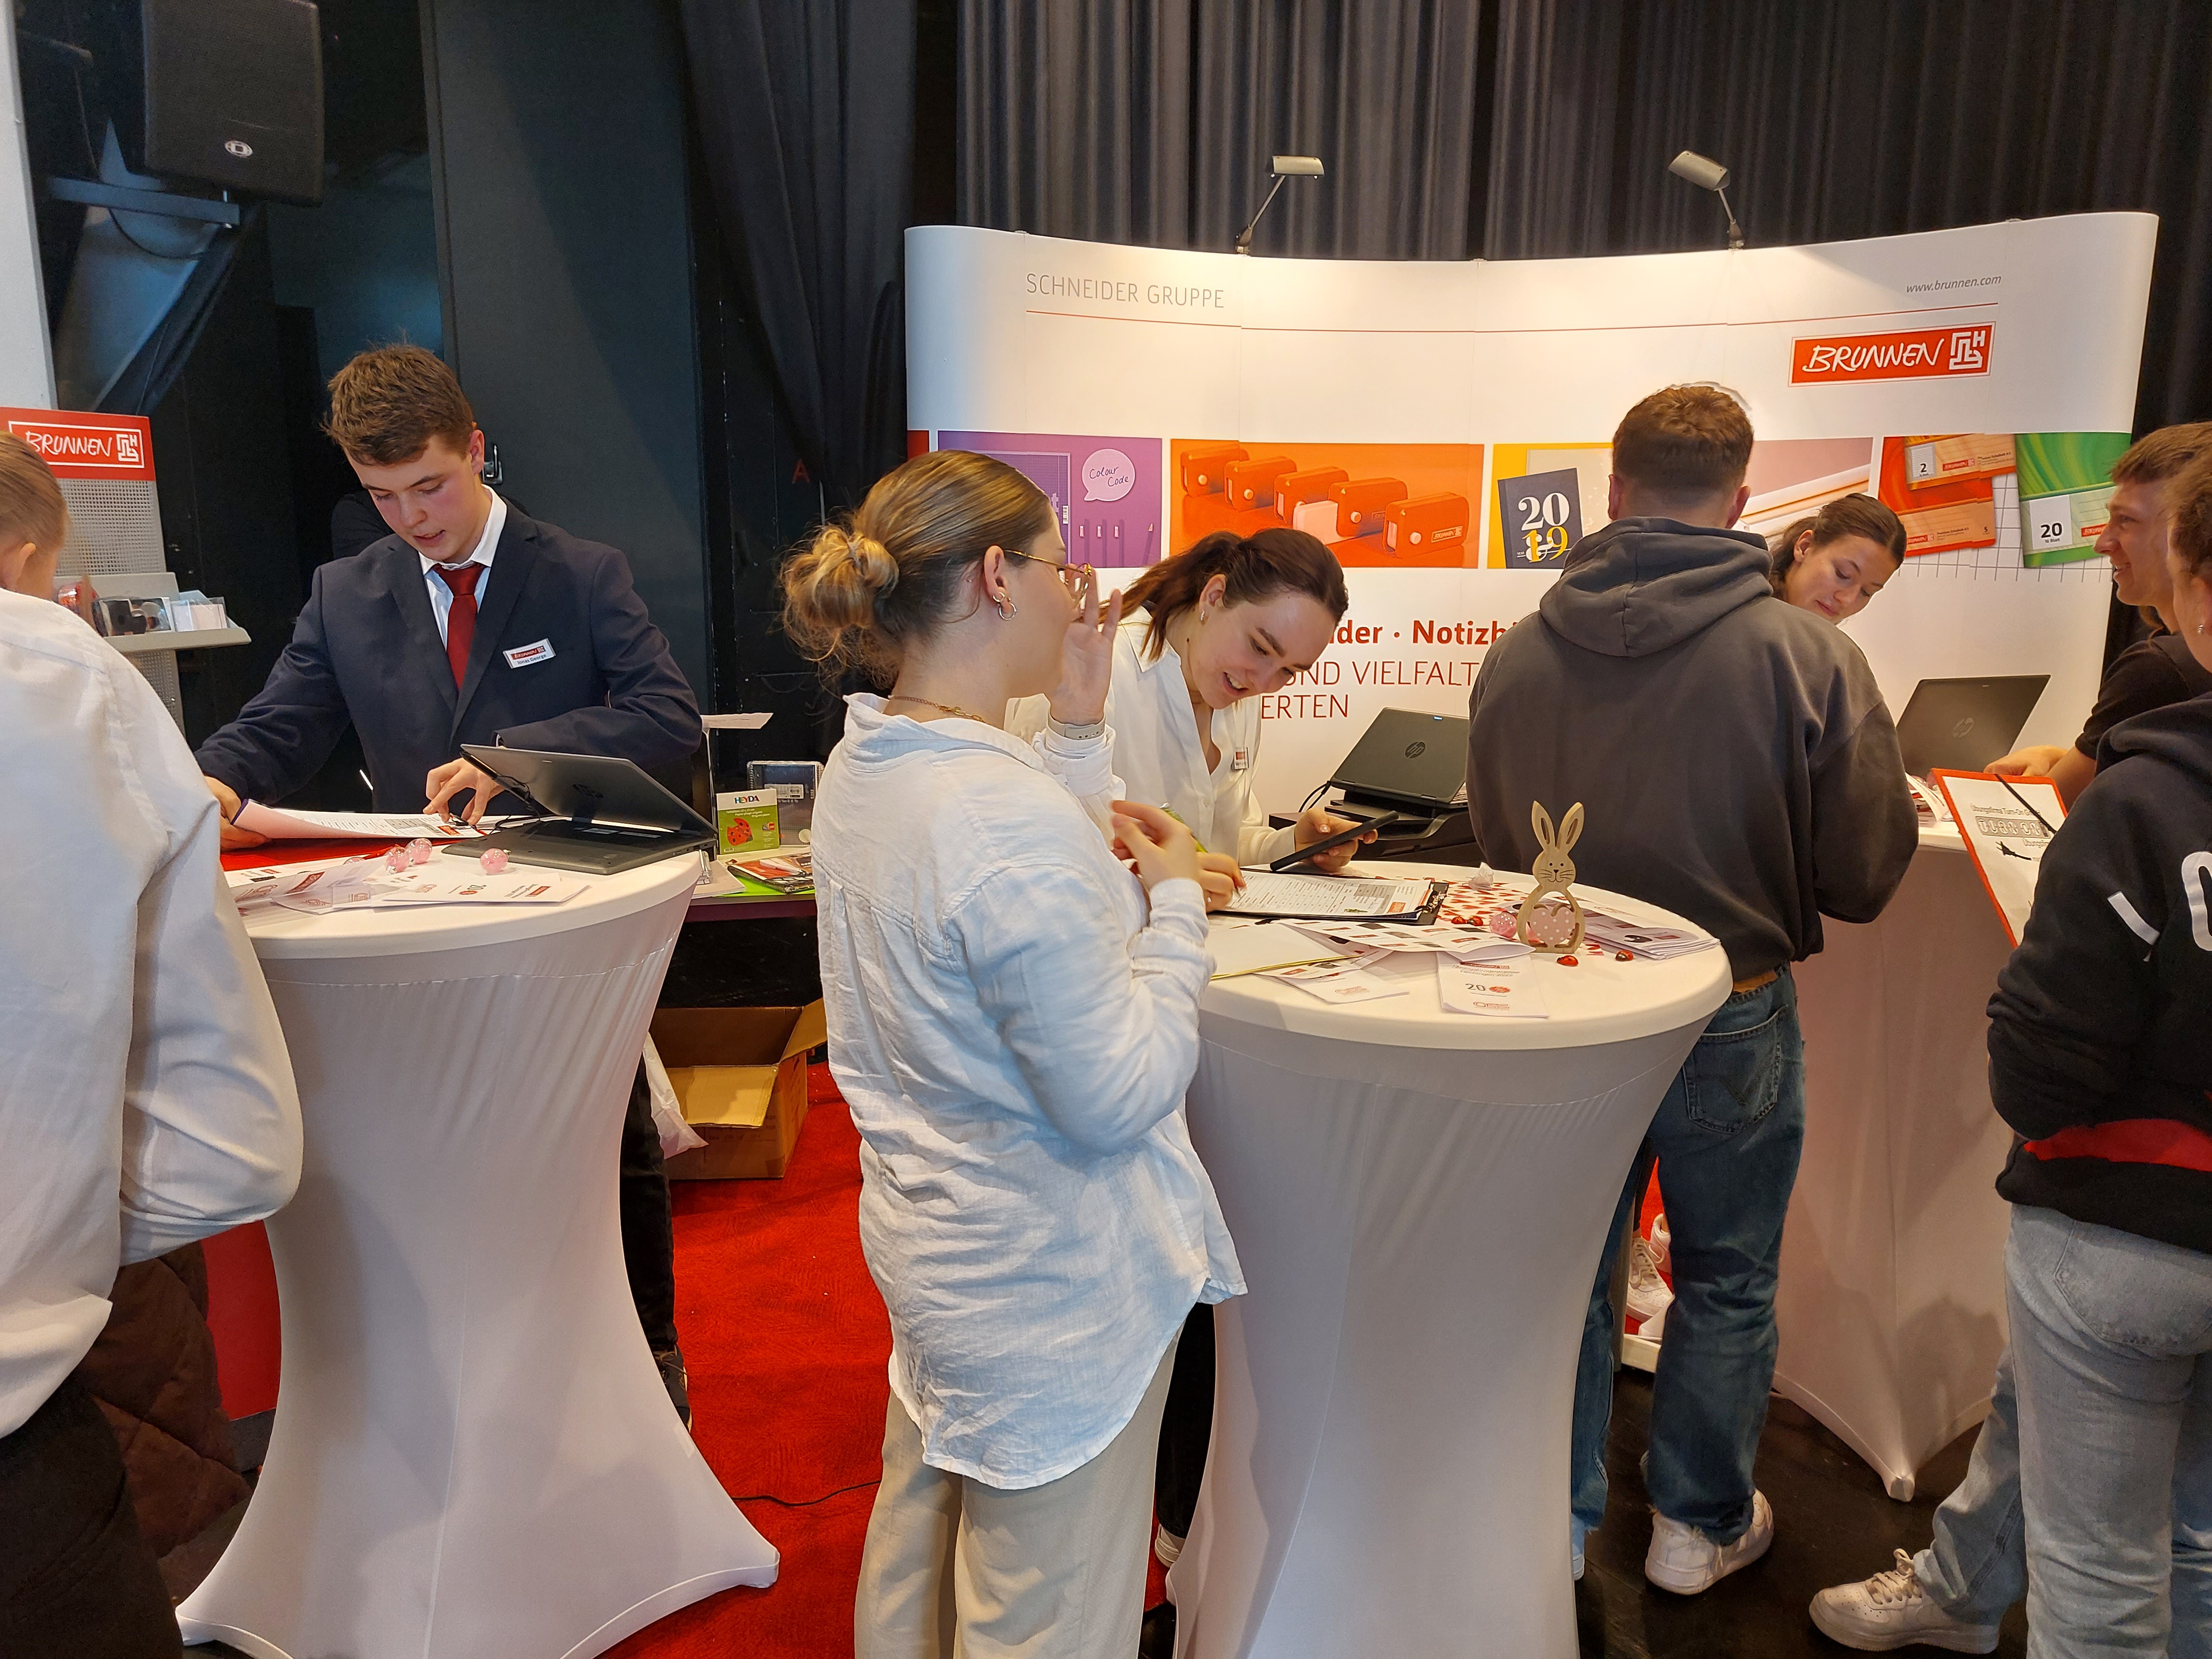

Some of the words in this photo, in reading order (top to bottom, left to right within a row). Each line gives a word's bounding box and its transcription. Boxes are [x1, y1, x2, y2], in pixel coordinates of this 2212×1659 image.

[1026, 273, 1139, 302] SCHNEIDER
[1147, 285, 1225, 309] GRUPPE
[1906, 276, 2002, 293] www.brunnen.com
[1802, 338, 1945, 372] BRUNNEN
[25, 430, 113, 457] BRUNNEN
[1089, 466, 1119, 479] Colour
[1920, 463, 1927, 473] 2
[1107, 475, 1129, 487] Code
[1518, 492, 1570, 531] 20
[2040, 522, 2063, 538] 20
[1329, 619, 1383, 644] der
[1413, 620, 1517, 645] Notizb
[1352, 661, 1480, 686] VIELFALT
[734, 795, 760, 804] HEYDA
[1465, 983, 1486, 991] 20
